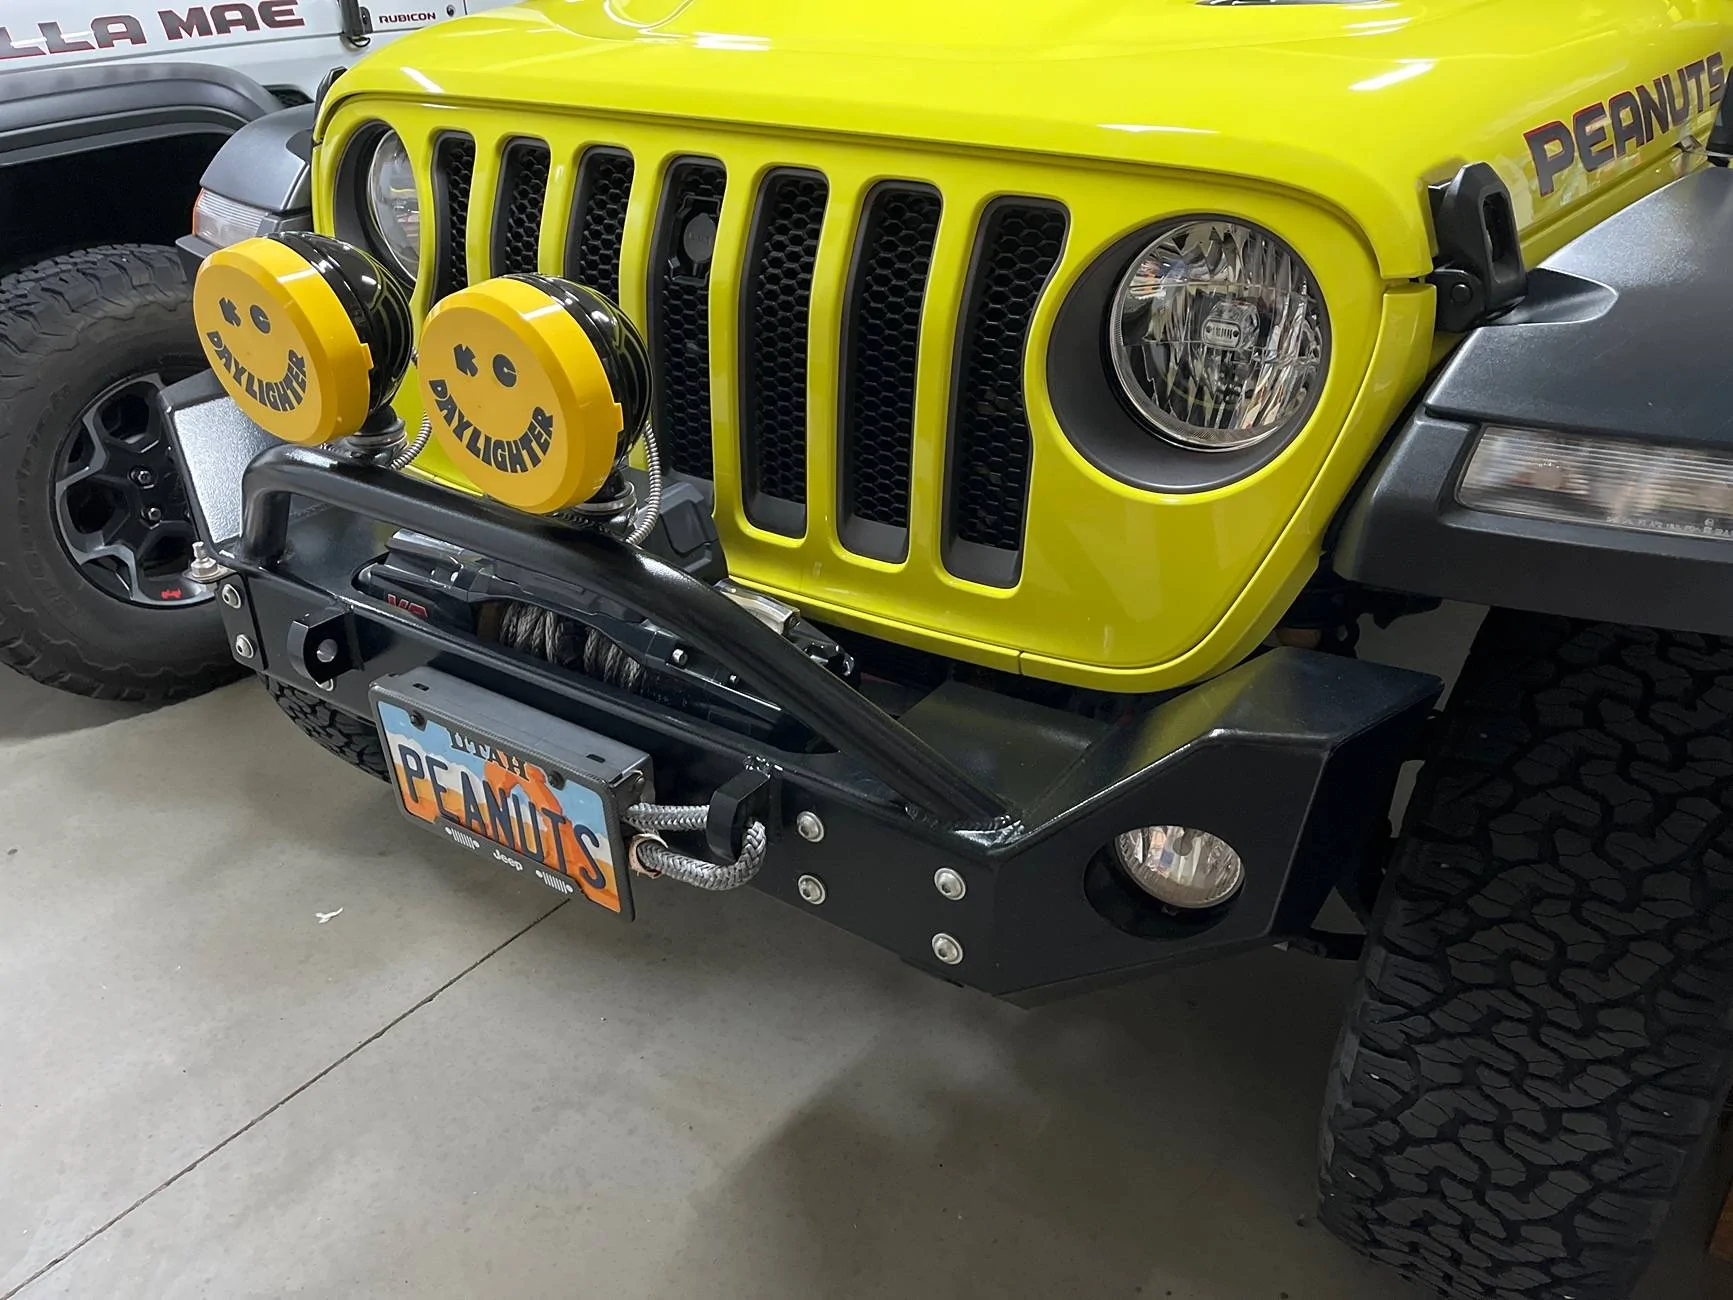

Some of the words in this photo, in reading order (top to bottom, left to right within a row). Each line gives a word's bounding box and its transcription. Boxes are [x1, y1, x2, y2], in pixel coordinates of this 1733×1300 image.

[0, 15, 147, 59] LLA
[157, 0, 305, 41] MAE
[379, 12, 436, 24] RUBICON
[1524, 51, 1726, 198] PEANUTS
[207, 330, 308, 413] DAYLIGHTER
[429, 379, 554, 473] DAYLIGHTER
[450, 731, 529, 781] UTAH
[398, 743, 606, 889] PEANUTS
[493, 849, 523, 872] Jeep
